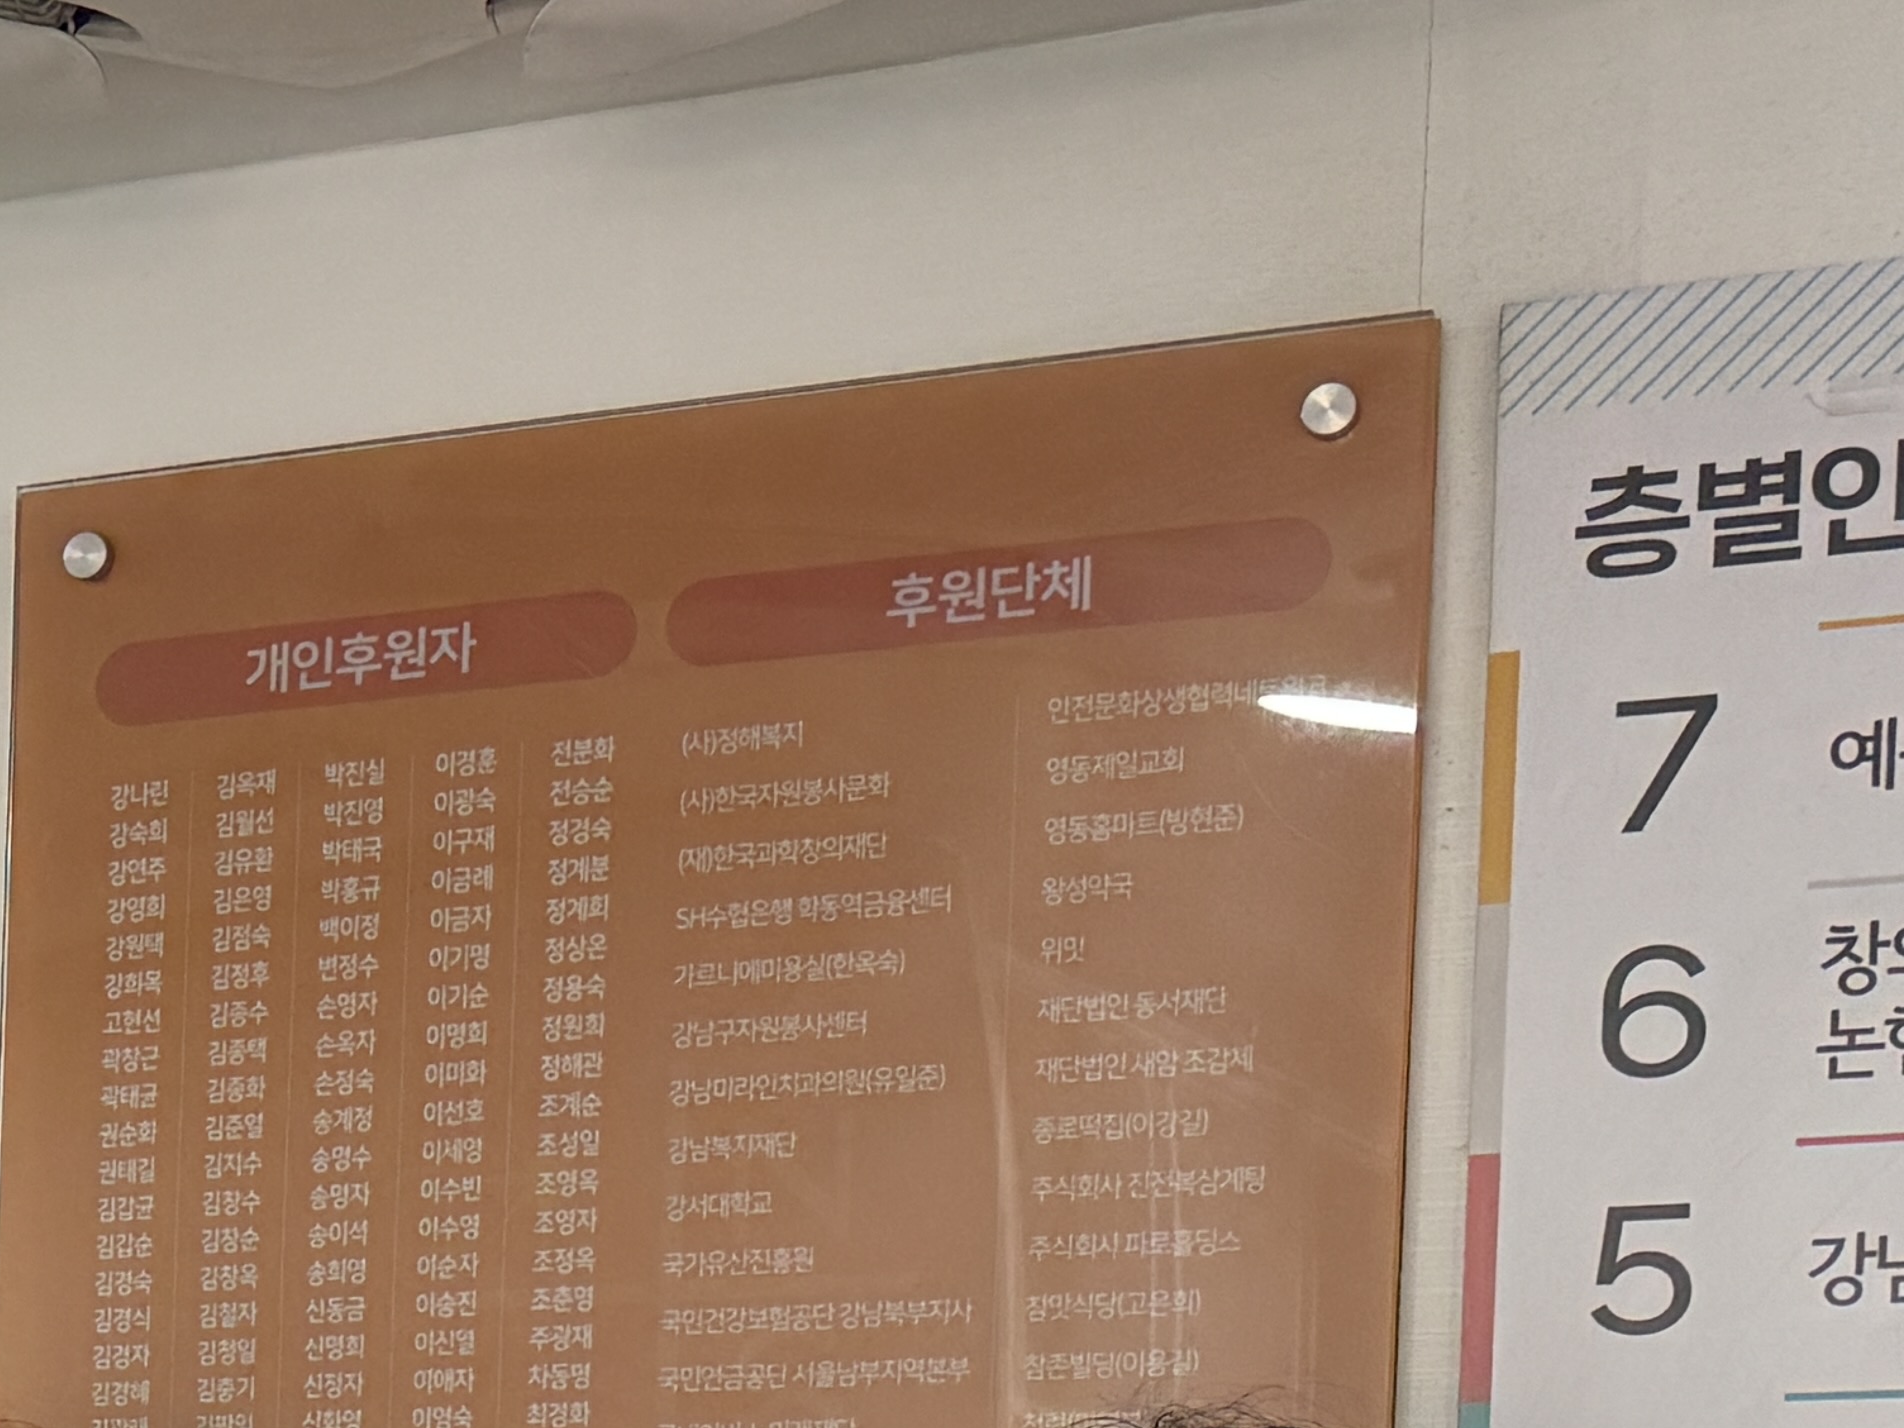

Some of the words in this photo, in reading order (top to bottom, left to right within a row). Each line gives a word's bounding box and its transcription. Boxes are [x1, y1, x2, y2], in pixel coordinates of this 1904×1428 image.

[886, 556, 1091, 628] 후원단체
[246, 622, 477, 692] 개인후원자
[1615, 692, 1718, 834] 7
[1601, 944, 1707, 1079] 6
[667, 1192, 772, 1222] 강서대학교
[1591, 1202, 1692, 1336] 5
